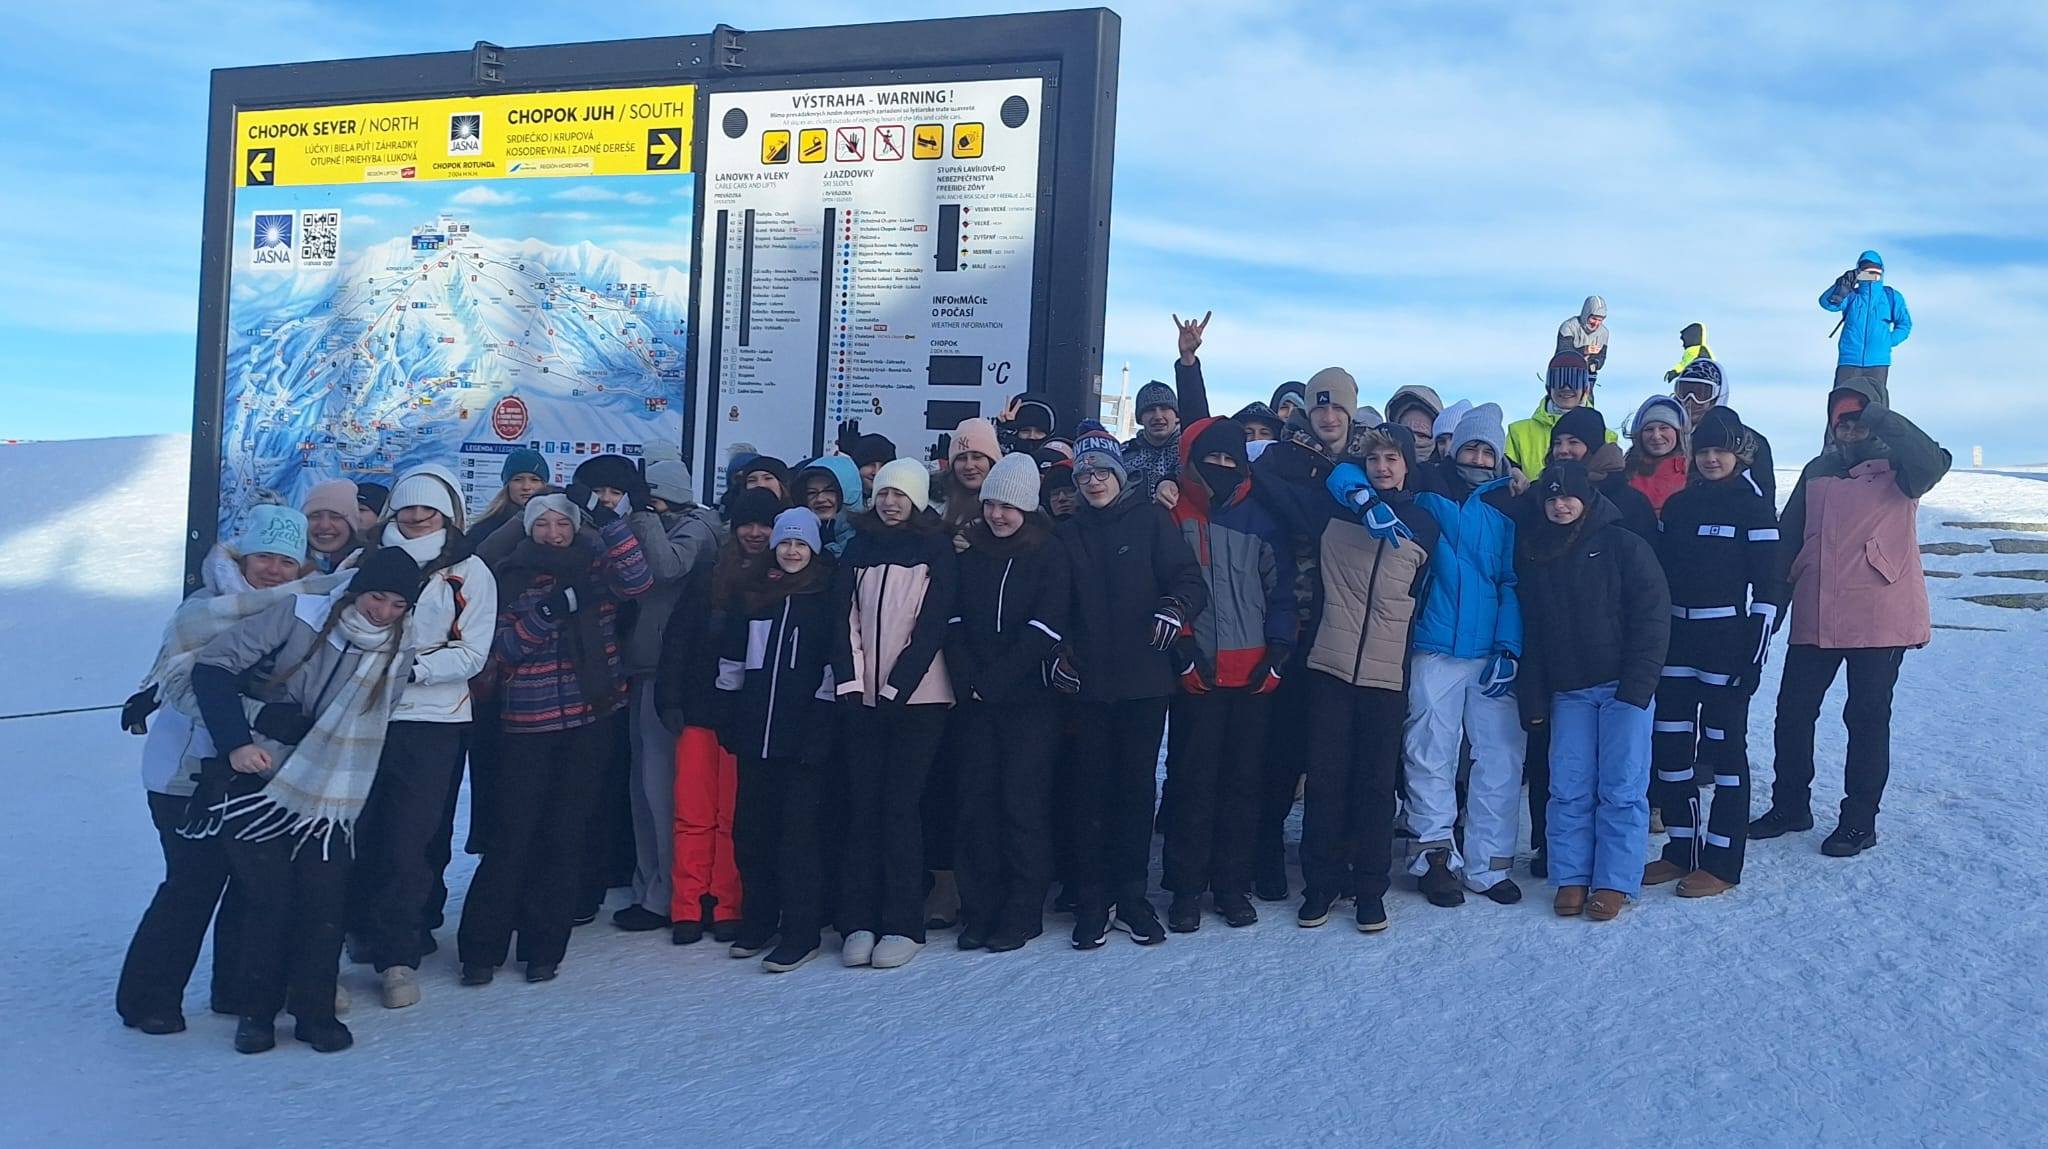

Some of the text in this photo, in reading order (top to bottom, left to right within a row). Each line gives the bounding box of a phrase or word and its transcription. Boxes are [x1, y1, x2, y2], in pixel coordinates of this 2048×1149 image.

[792, 92, 865, 109] VÝSTRAHA
[508, 107, 577, 125] CHOPOK
[583, 105, 614, 122] JUH
[629, 102, 684, 120] SOUTH
[248, 123, 308, 139] CHOPOK
[313, 120, 356, 136] SEVER
[369, 116, 419, 133] NORTH
[507, 129, 594, 144] SRDIEČKO KRUPOVÁ
[305, 142, 330, 154] LÚČKY
[334, 143, 355, 153] BIELA
[376, 140, 418, 152] ZÁHRADKY
[506, 141, 636, 157] KOSODREVINA ZADNÉ DEREŠE
[311, 152, 418, 167] OTUPNÉ PRIEHYBA LUKOVÁ
[432, 161, 495, 170] CHOPOK ROTUNDA
[715, 173, 754, 181] LANOVKY
[764, 172, 789, 180] VLEKY
[931, 306, 974, 317] O POČASÍ
[931, 321, 1003, 329] WEATHER INFORMATION
